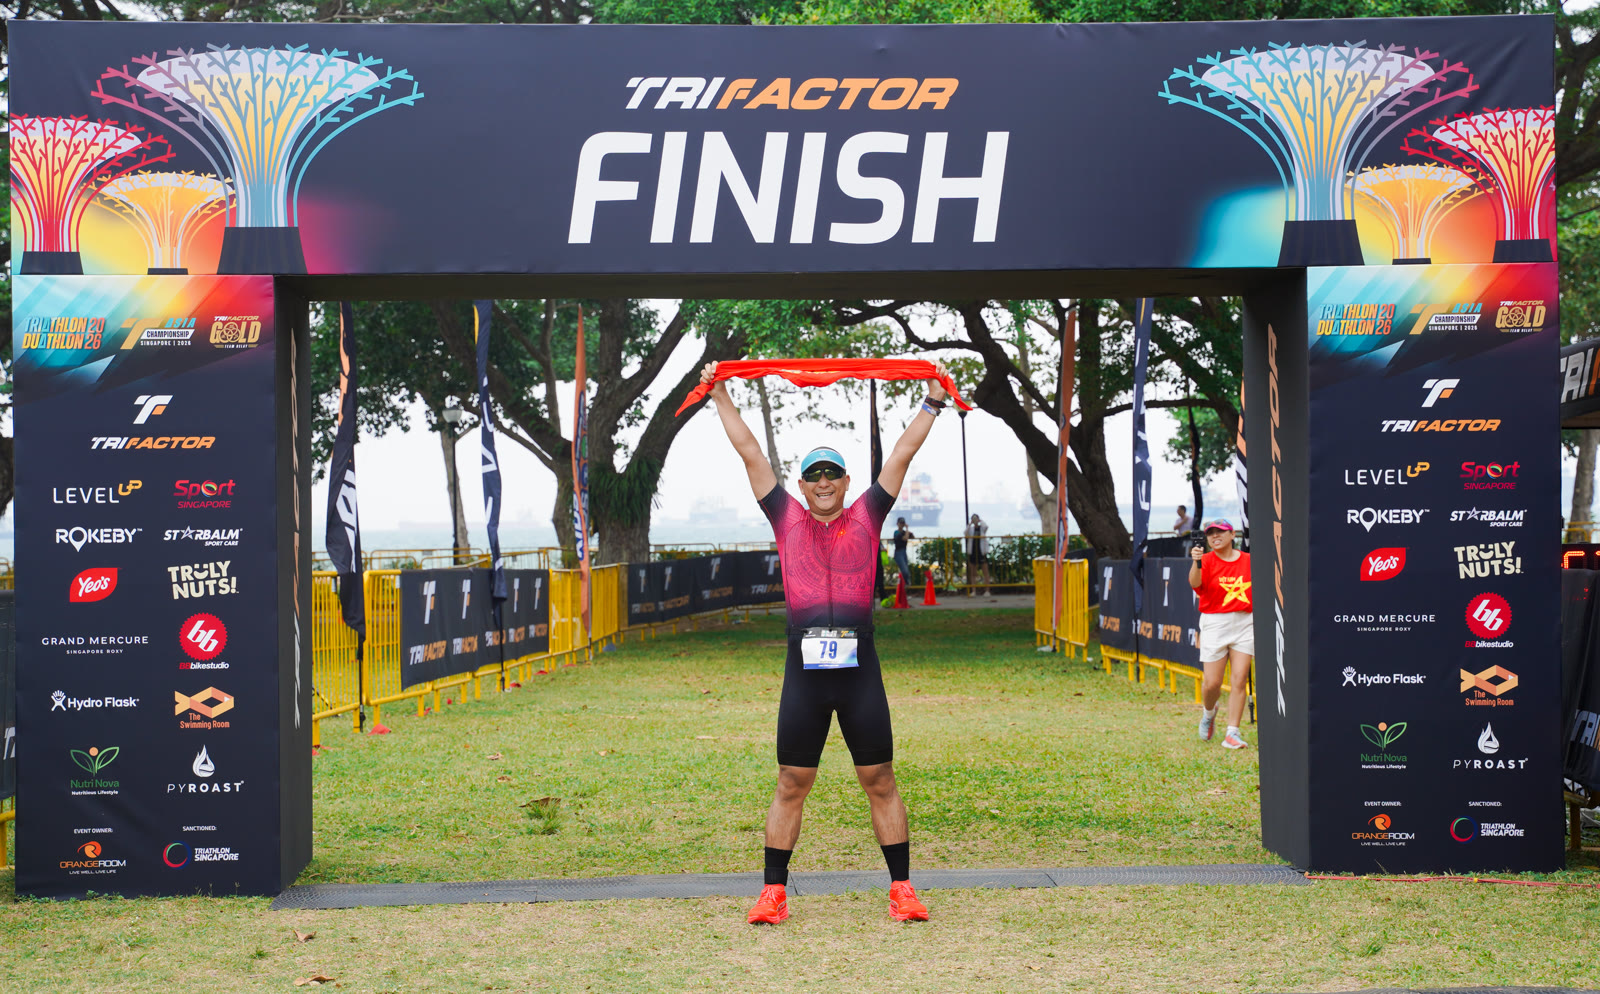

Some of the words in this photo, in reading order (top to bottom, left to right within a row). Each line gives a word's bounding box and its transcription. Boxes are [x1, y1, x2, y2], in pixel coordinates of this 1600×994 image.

[625, 77, 960, 110] TRIFACTOR
[568, 131, 1010, 244] FINISH
[1320, 303, 1378, 319] TRIATHLON
[1378, 303, 1396, 319] 20
[1452, 303, 1483, 313] ASIA
[165, 318, 197, 328] ASIA
[1434, 315, 1477, 323] CHAMPIONSHIP
[1495, 305, 1547, 328] GOLD
[25, 317, 87, 333] TRIATHLON
[88, 317, 105, 333] 20
[1316, 320, 1375, 335] DUATHLON
[1375, 319, 1392, 335] 26
[209, 321, 262, 344] GOLD
[22, 333, 85, 349] DUATHLON
[84, 333, 102, 349] 26
[1381, 419, 1501, 432] TRIFACTOR
[91, 437, 216, 450] TRIFACTOR
[1345, 469, 1408, 485] LEVEL
[1460, 461, 1521, 481] Sport
[173, 479, 236, 499] Sport
[1464, 482, 1516, 490] SINGAPORE
[53, 487, 120, 504] LEVEL
[1268, 323, 1286, 717] TRIFACTOR
[1368, 556, 1399, 576] Yeo's
[1459, 557, 1521, 579] NUTS!
[78, 576, 110, 597] Yeo's
[172, 577, 237, 599] NUTS!
[1334, 615, 1375, 623] GRAND
[1379, 614, 1436, 623] MERCURE
[41, 637, 85, 645] GRAND
[89, 636, 149, 645] MERCURE
[1465, 640, 1514, 648] BBbikestudio
[819, 640, 838, 659] 79
[179, 662, 229, 670] BBbikestudio
[1358, 674, 1391, 687] Hydro
[1393, 673, 1423, 684] Flask
[1474, 690, 1485, 698] The
[67, 698, 103, 711] Hydro
[105, 697, 137, 708] Flask
[1465, 698, 1496, 707] Swimming
[1497, 698, 1514, 706] Room
[189, 713, 201, 721] The
[180, 721, 211, 730] Swimming
[213, 721, 230, 729] Room
[1360, 753, 1383, 762] Nutri
[1384, 754, 1407, 762] Nova
[1453, 759, 1526, 769] PYROAST
[70, 779, 94, 788] Nutri
[95, 779, 120, 788] Nova
[167, 782, 242, 793] PYROAST
[1352, 832, 1415, 840] ORANGEROOM
[1480, 829, 1524, 837] SINGAPORE
[59, 860, 126, 869] ORANGEROOM
[194, 854, 240, 862] SINGAPORE
